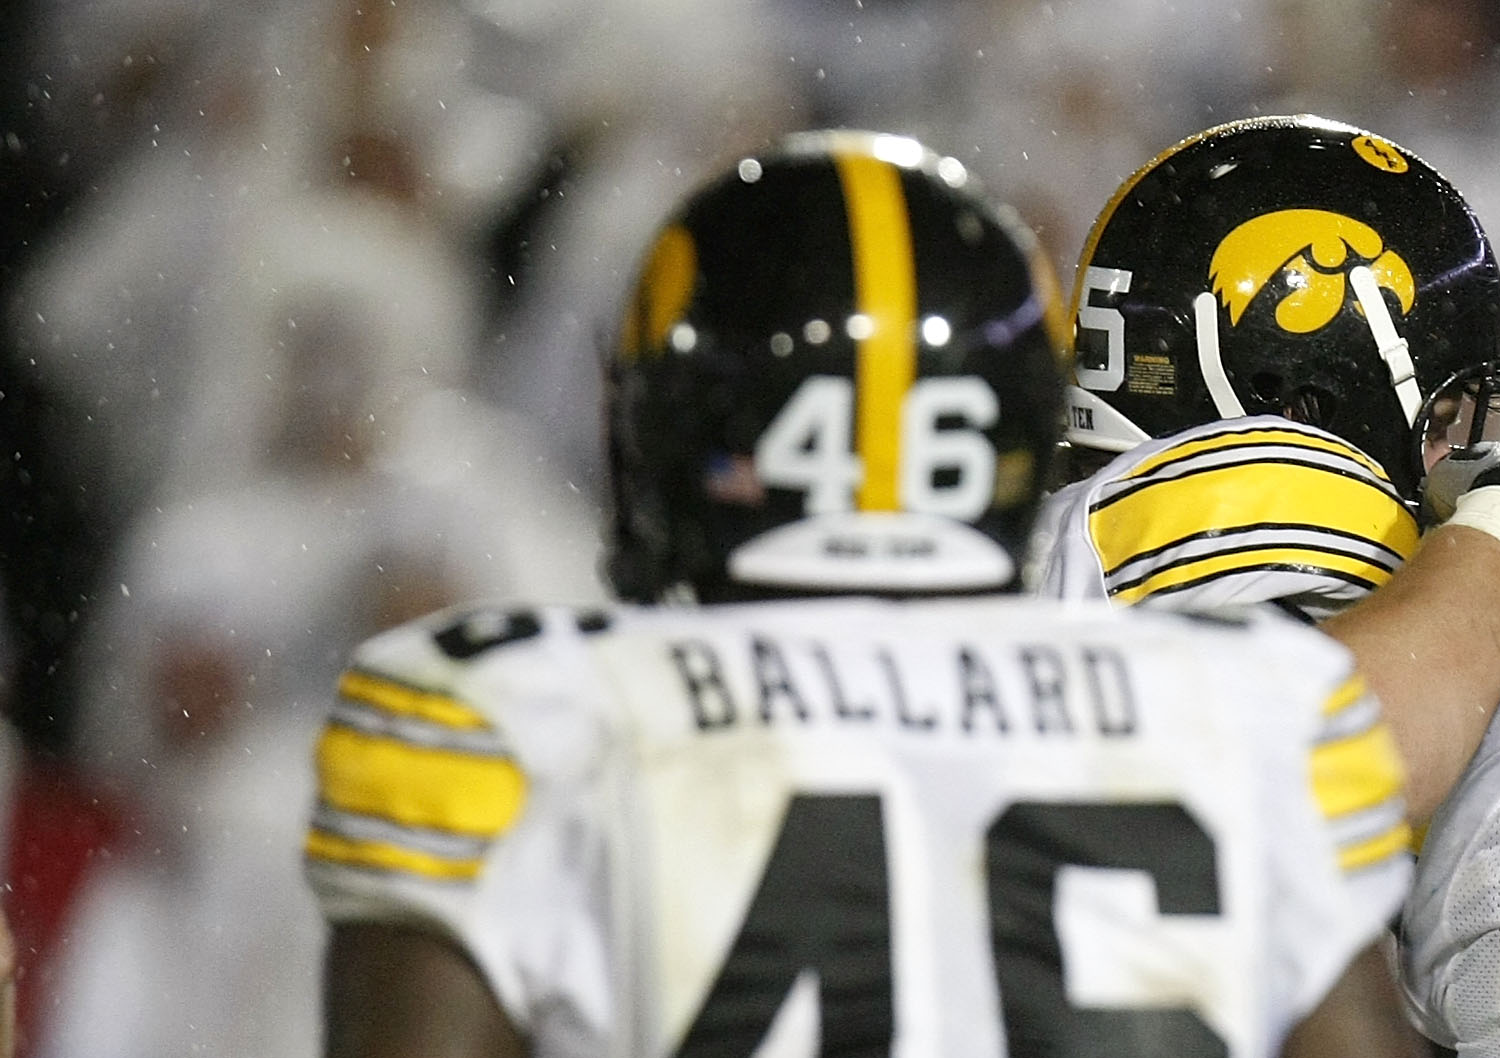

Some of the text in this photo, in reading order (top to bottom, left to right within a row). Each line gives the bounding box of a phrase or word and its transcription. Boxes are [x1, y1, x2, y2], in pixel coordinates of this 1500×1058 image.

[1074, 265, 1132, 391] 5
[755, 375, 999, 523] 46
[1072, 406, 1094, 430] TEN
[668, 634, 1143, 738] BALLARD
